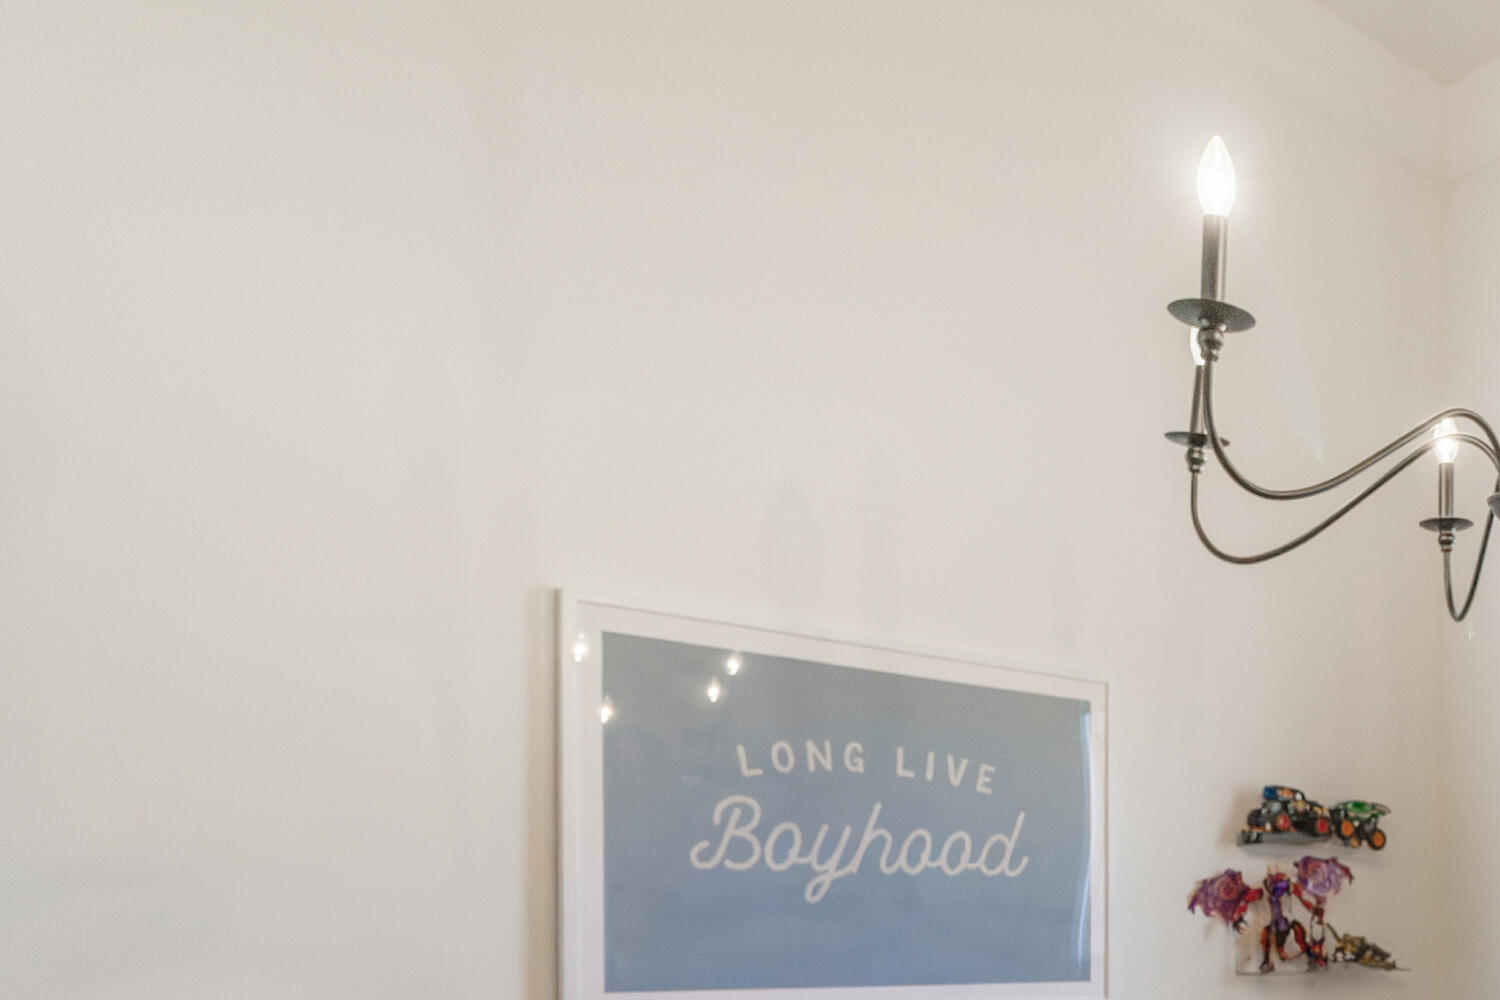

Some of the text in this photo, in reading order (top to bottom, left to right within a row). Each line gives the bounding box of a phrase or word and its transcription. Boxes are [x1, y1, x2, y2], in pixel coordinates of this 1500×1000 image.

[736, 739, 996, 795] LONG LIVE
[689, 795, 1029, 904] Boyhood
